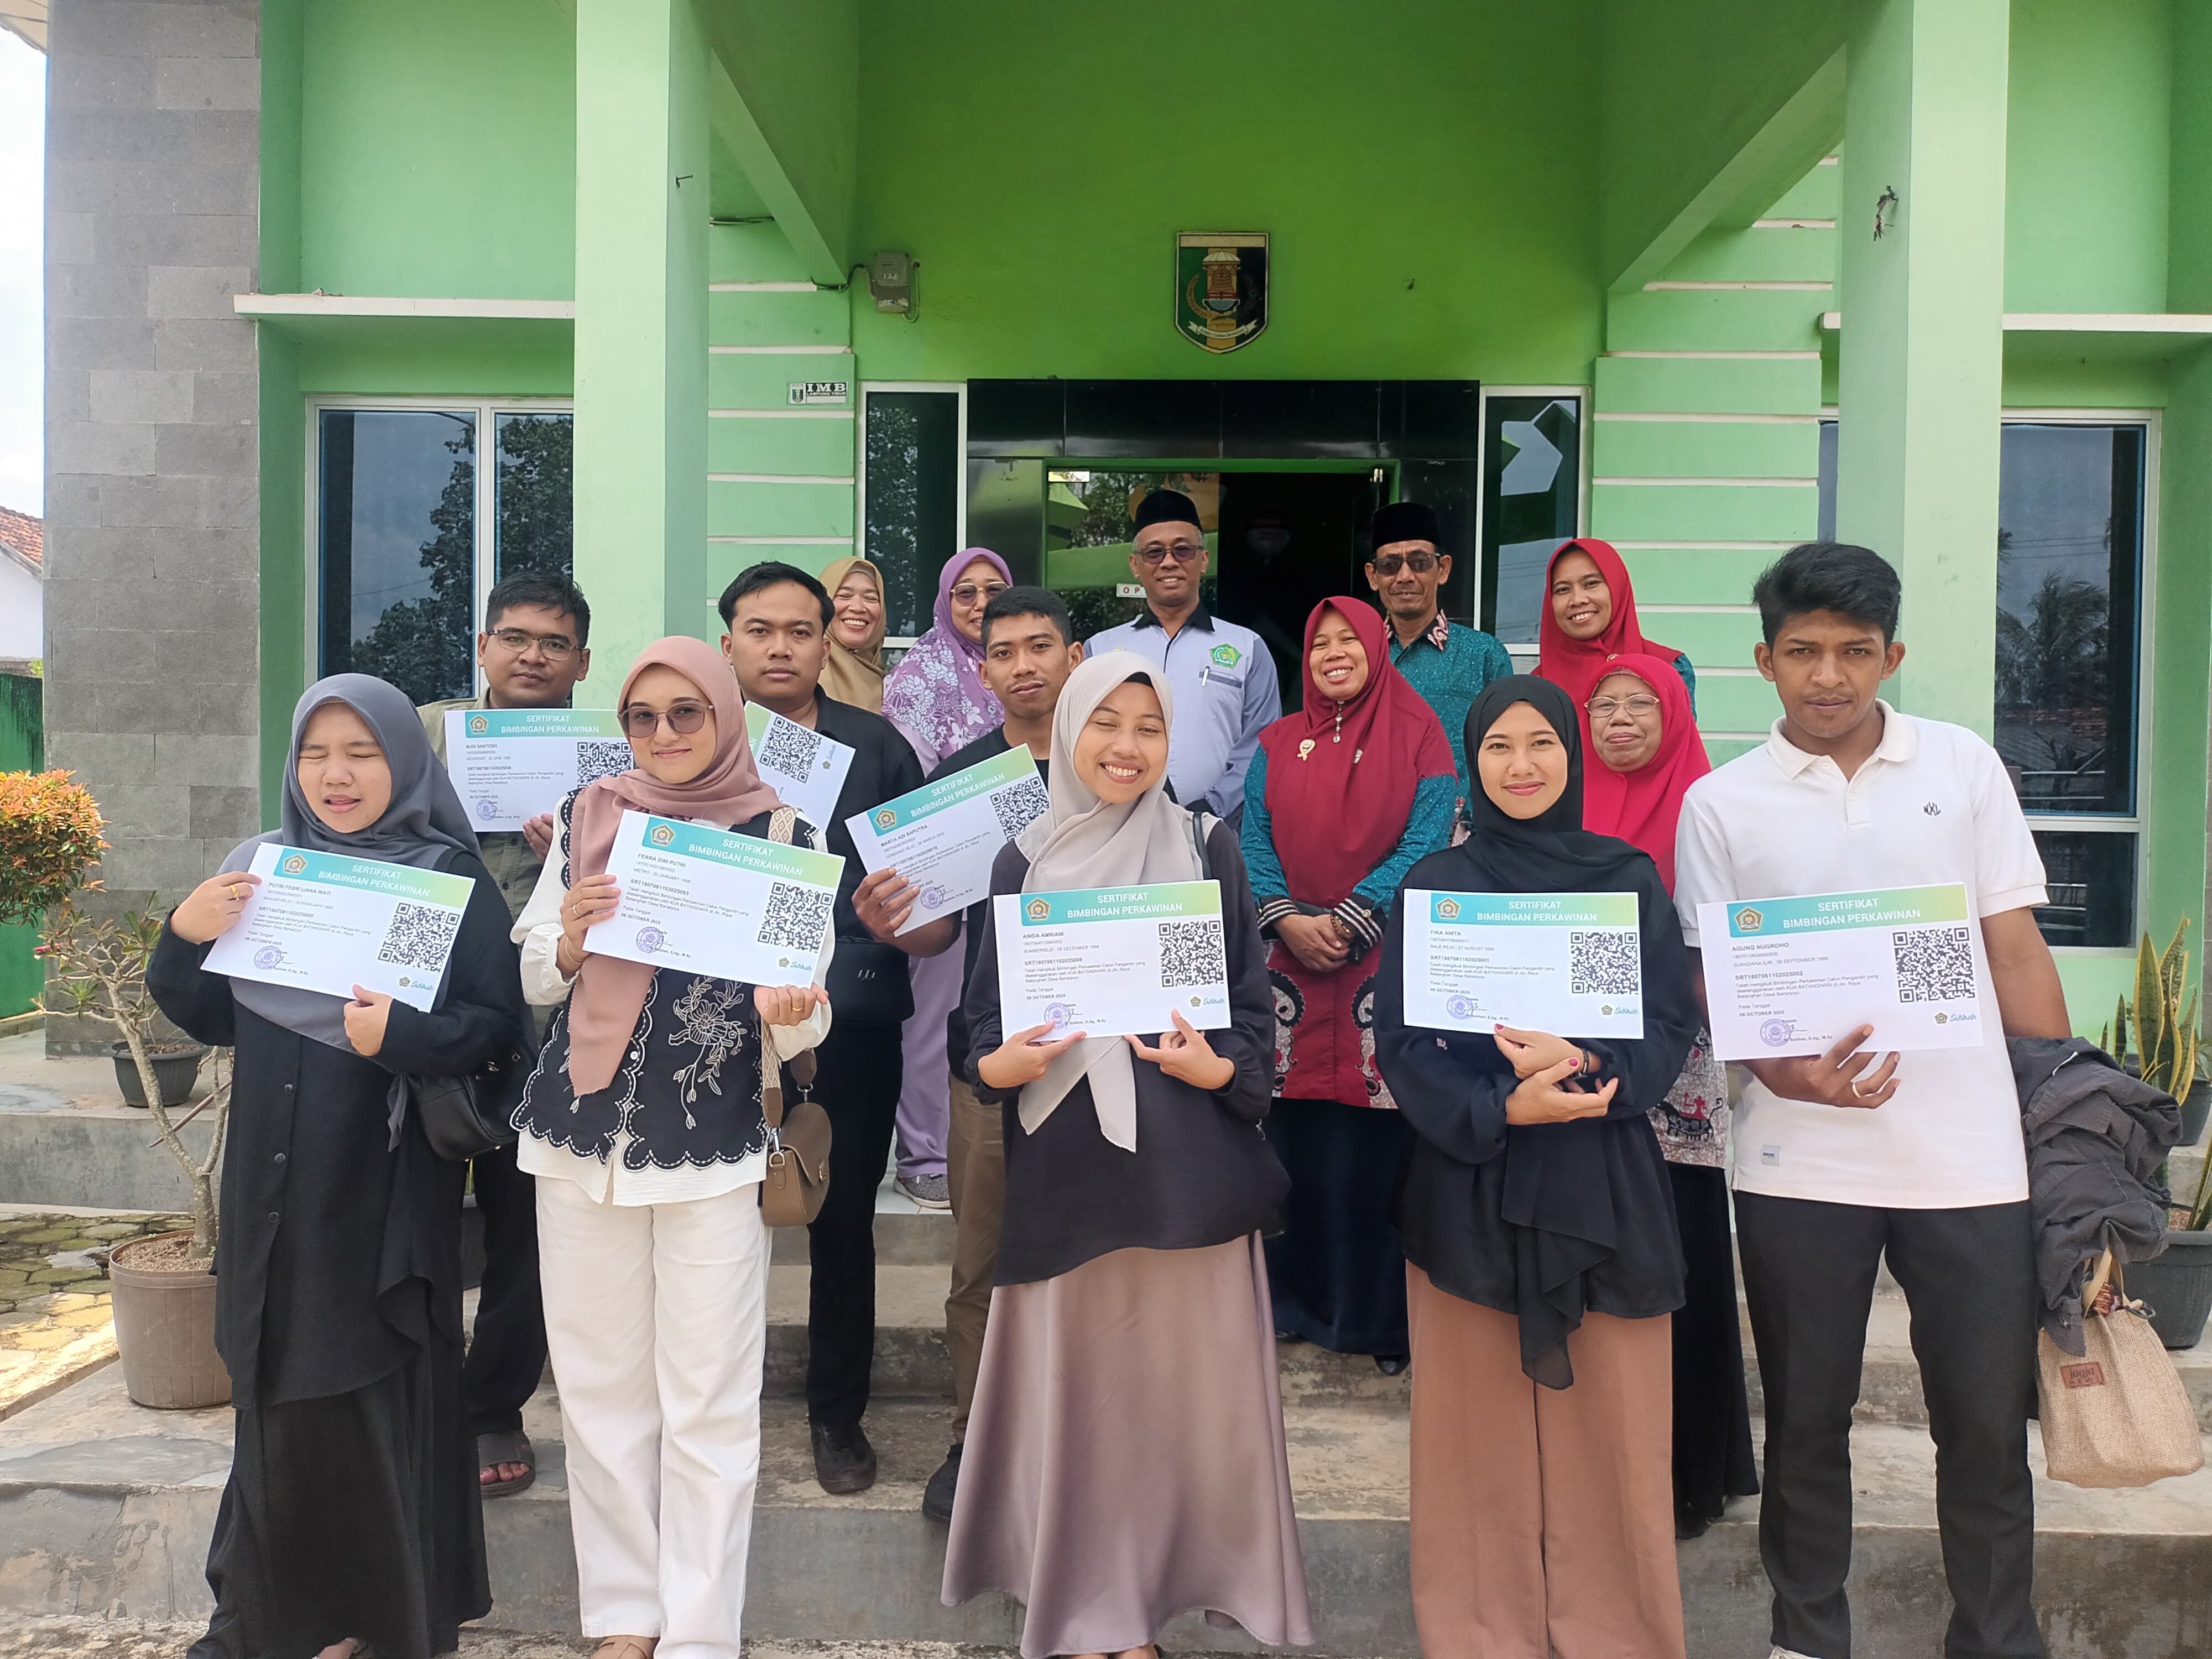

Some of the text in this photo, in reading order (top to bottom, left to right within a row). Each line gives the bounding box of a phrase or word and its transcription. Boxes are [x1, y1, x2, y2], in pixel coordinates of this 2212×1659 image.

[807, 383, 846, 392] IMB
[930, 773, 974, 797] SERTIFIKAT
[910, 772, 1005, 817] BIMBINGAN PERKAWINAN
[880, 837, 898, 847] MARTA
[906, 824, 928, 837] SAPUTRA
[721, 838, 774, 857] SERTIFIKAT
[637, 853, 657, 862] FERRA
[687, 843, 802, 875] BIMBINGAN PERKAWINAN
[351, 864, 401, 879] SERTIFIKAT
[317, 870, 430, 896] BIMBINGAN PERKAWINAN
[1097, 891, 1148, 904] SERTIFIKAT
[1508, 901, 1561, 909] SERTIFIKAT
[1817, 897, 1879, 912] SERTIFIKAT
[1067, 902, 1182, 918] BIMBINGAN PERKAWINAN
[1477, 912, 1531, 921] BIMBINGAN
[627, 914, 650, 922] OCTOBER
[1782, 908, 1921, 928] BIMBINGAN PERKAWINAN
